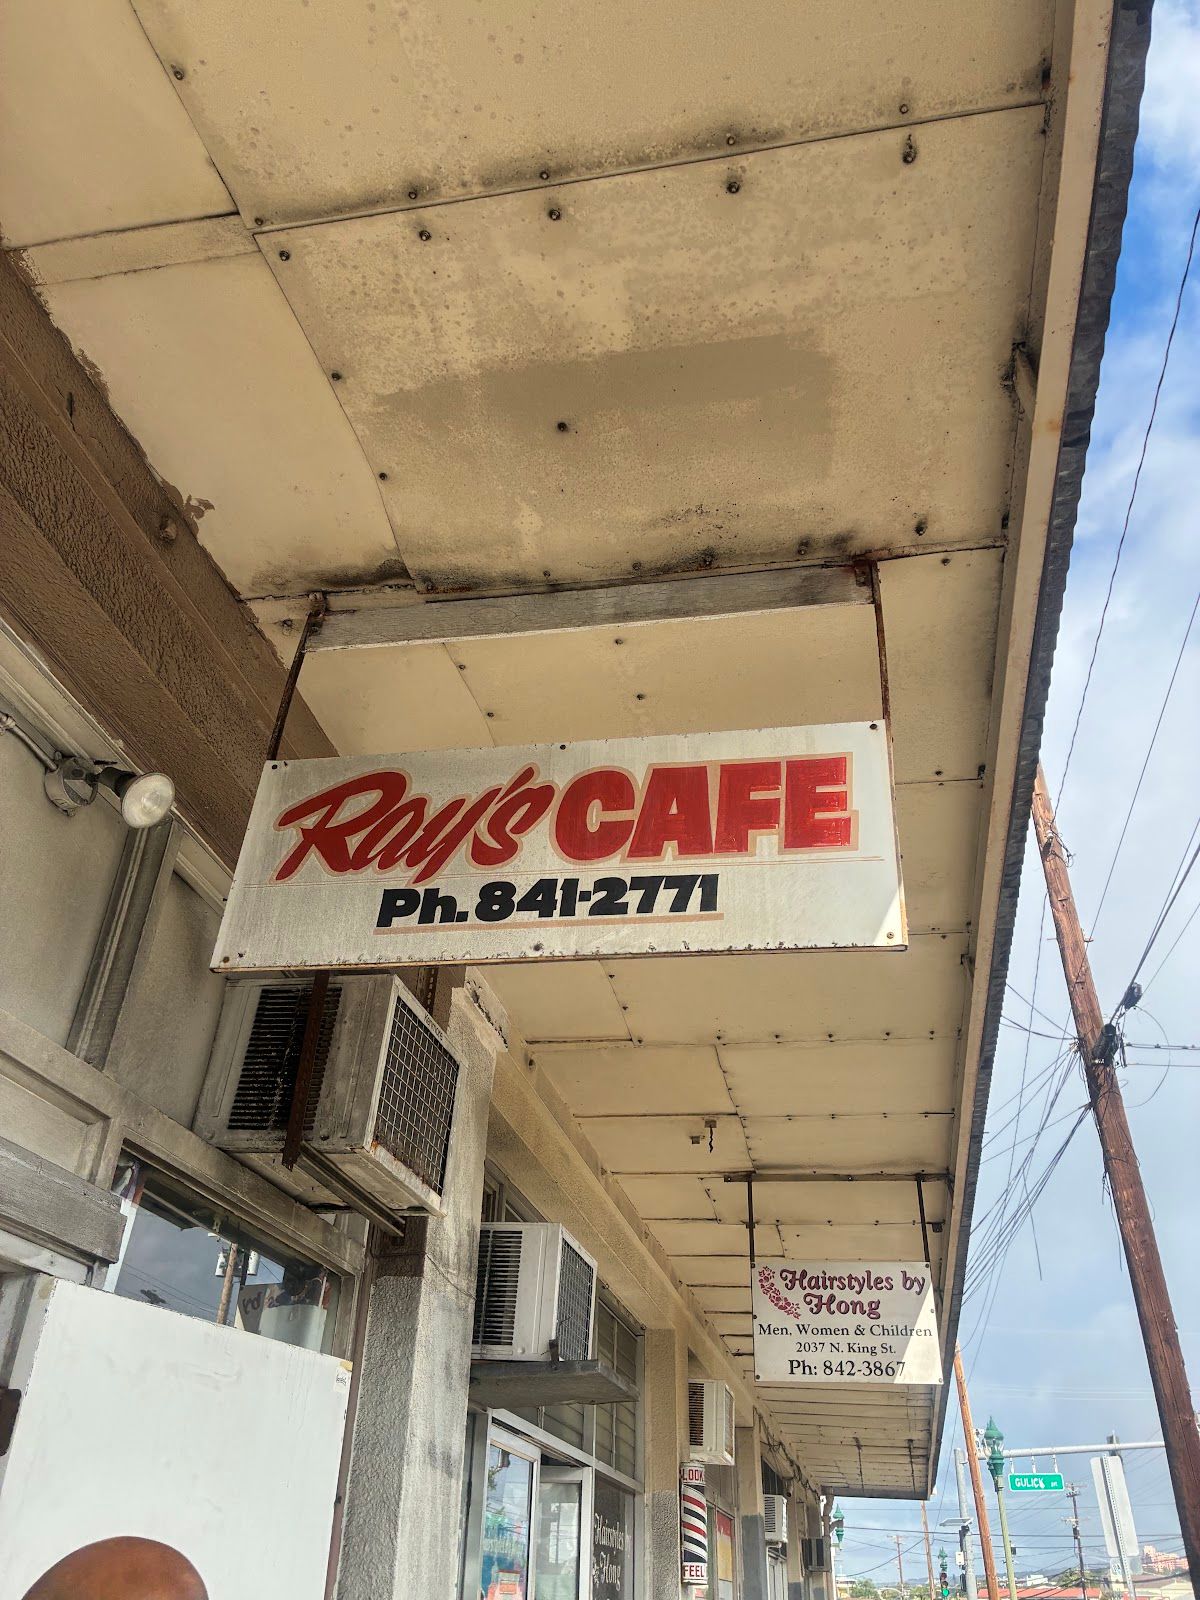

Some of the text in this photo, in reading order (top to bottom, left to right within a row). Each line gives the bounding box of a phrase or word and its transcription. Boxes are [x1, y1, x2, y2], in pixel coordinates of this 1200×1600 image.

[275, 757, 851, 885] Ray's CAFE
[376, 873, 719, 928] Ph. 841-2771
[780, 1268, 926, 1296] Hairstyles by
[803, 1292, 881, 1320] Hong
[796, 1324, 850, 1336] Women
[854, 1324, 866, 1337] &
[869, 1325, 933, 1337] Children
[796, 1342, 897, 1356] 2037 N. King St.
[788, 1360, 906, 1377] Ph: 842-3867
[682, 1469, 705, 1481] LOOK
[1015, 1477, 1045, 1488] GULICK
[599, 1551, 621, 1592] Hong
[683, 1565, 705, 1578] FEEL
